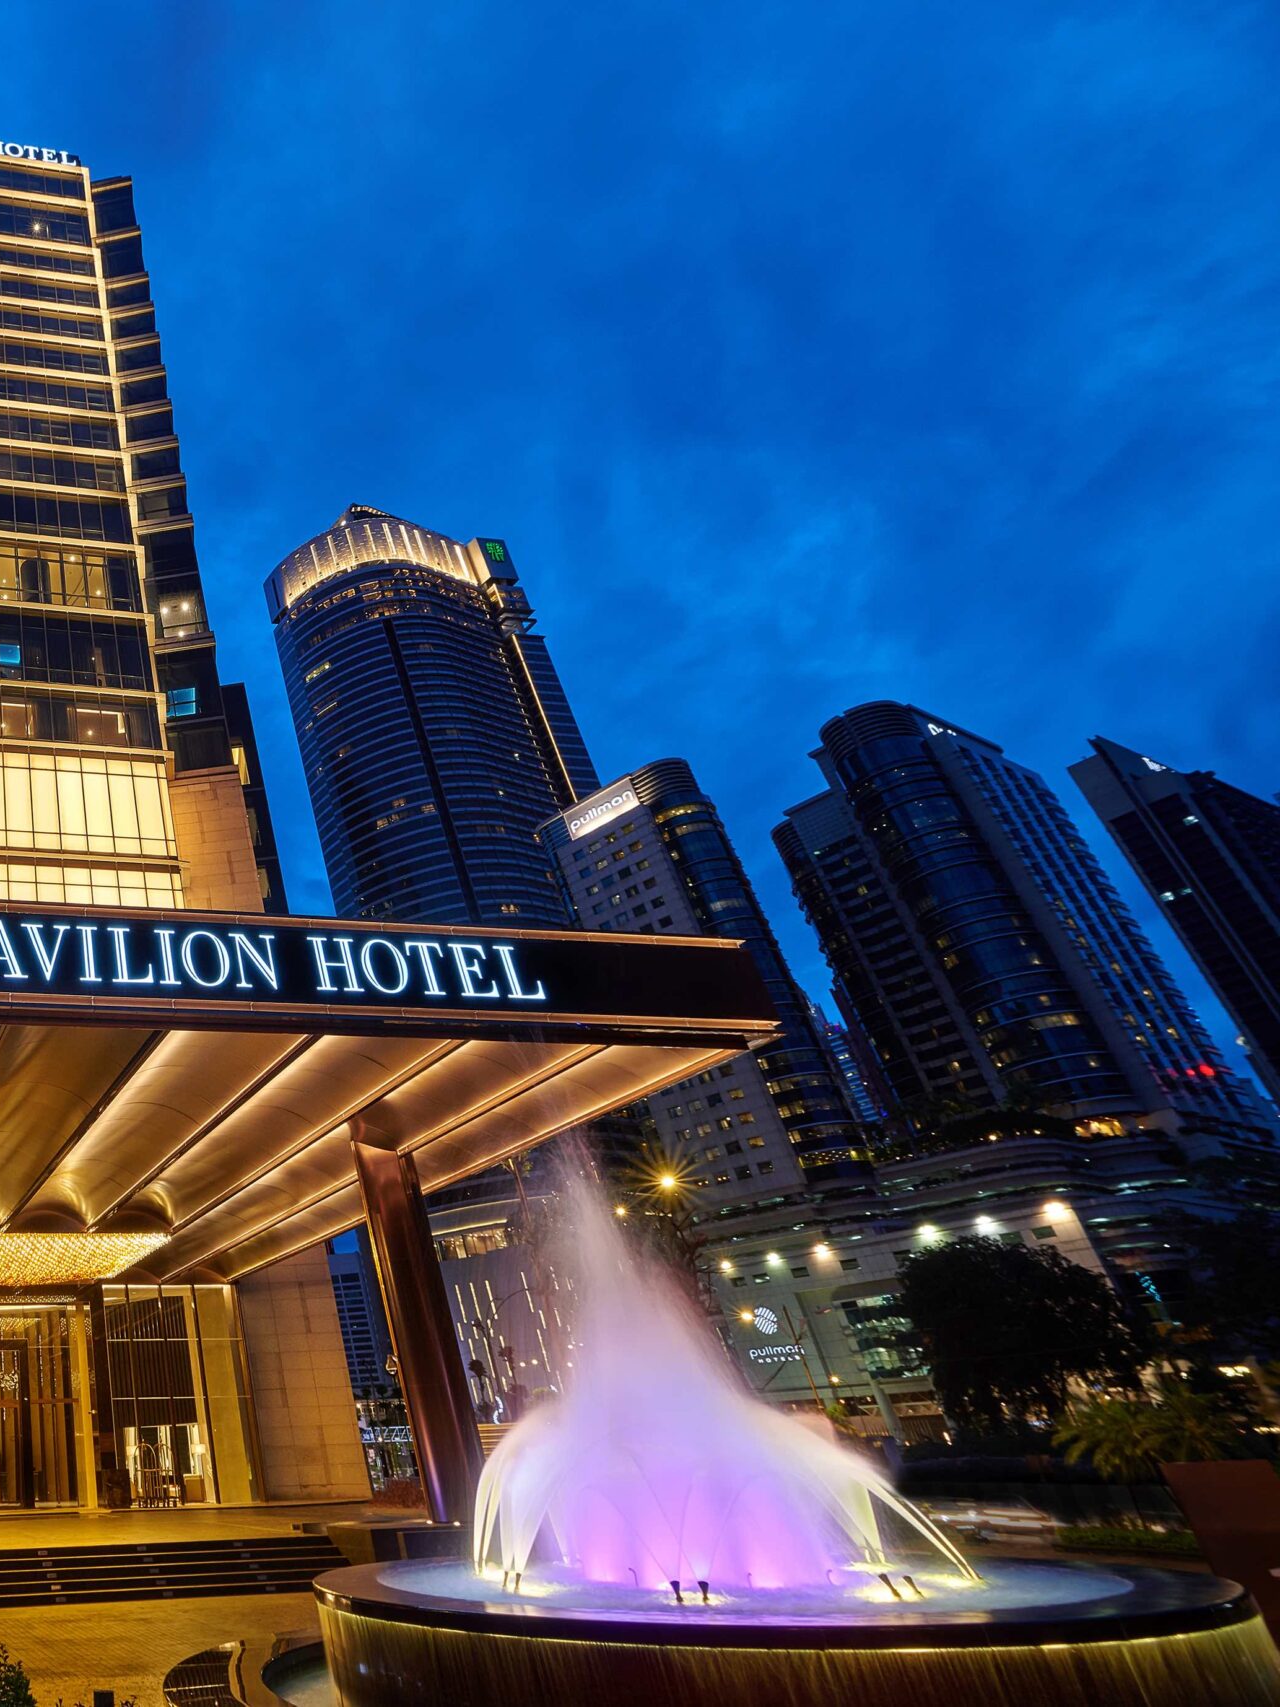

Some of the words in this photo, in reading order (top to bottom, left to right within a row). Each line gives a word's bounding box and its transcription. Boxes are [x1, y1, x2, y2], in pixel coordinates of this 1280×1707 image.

[570, 790, 634, 834] pullman
[306, 935, 548, 1000] HOTEL
[749, 1344, 806, 1360] pullman
